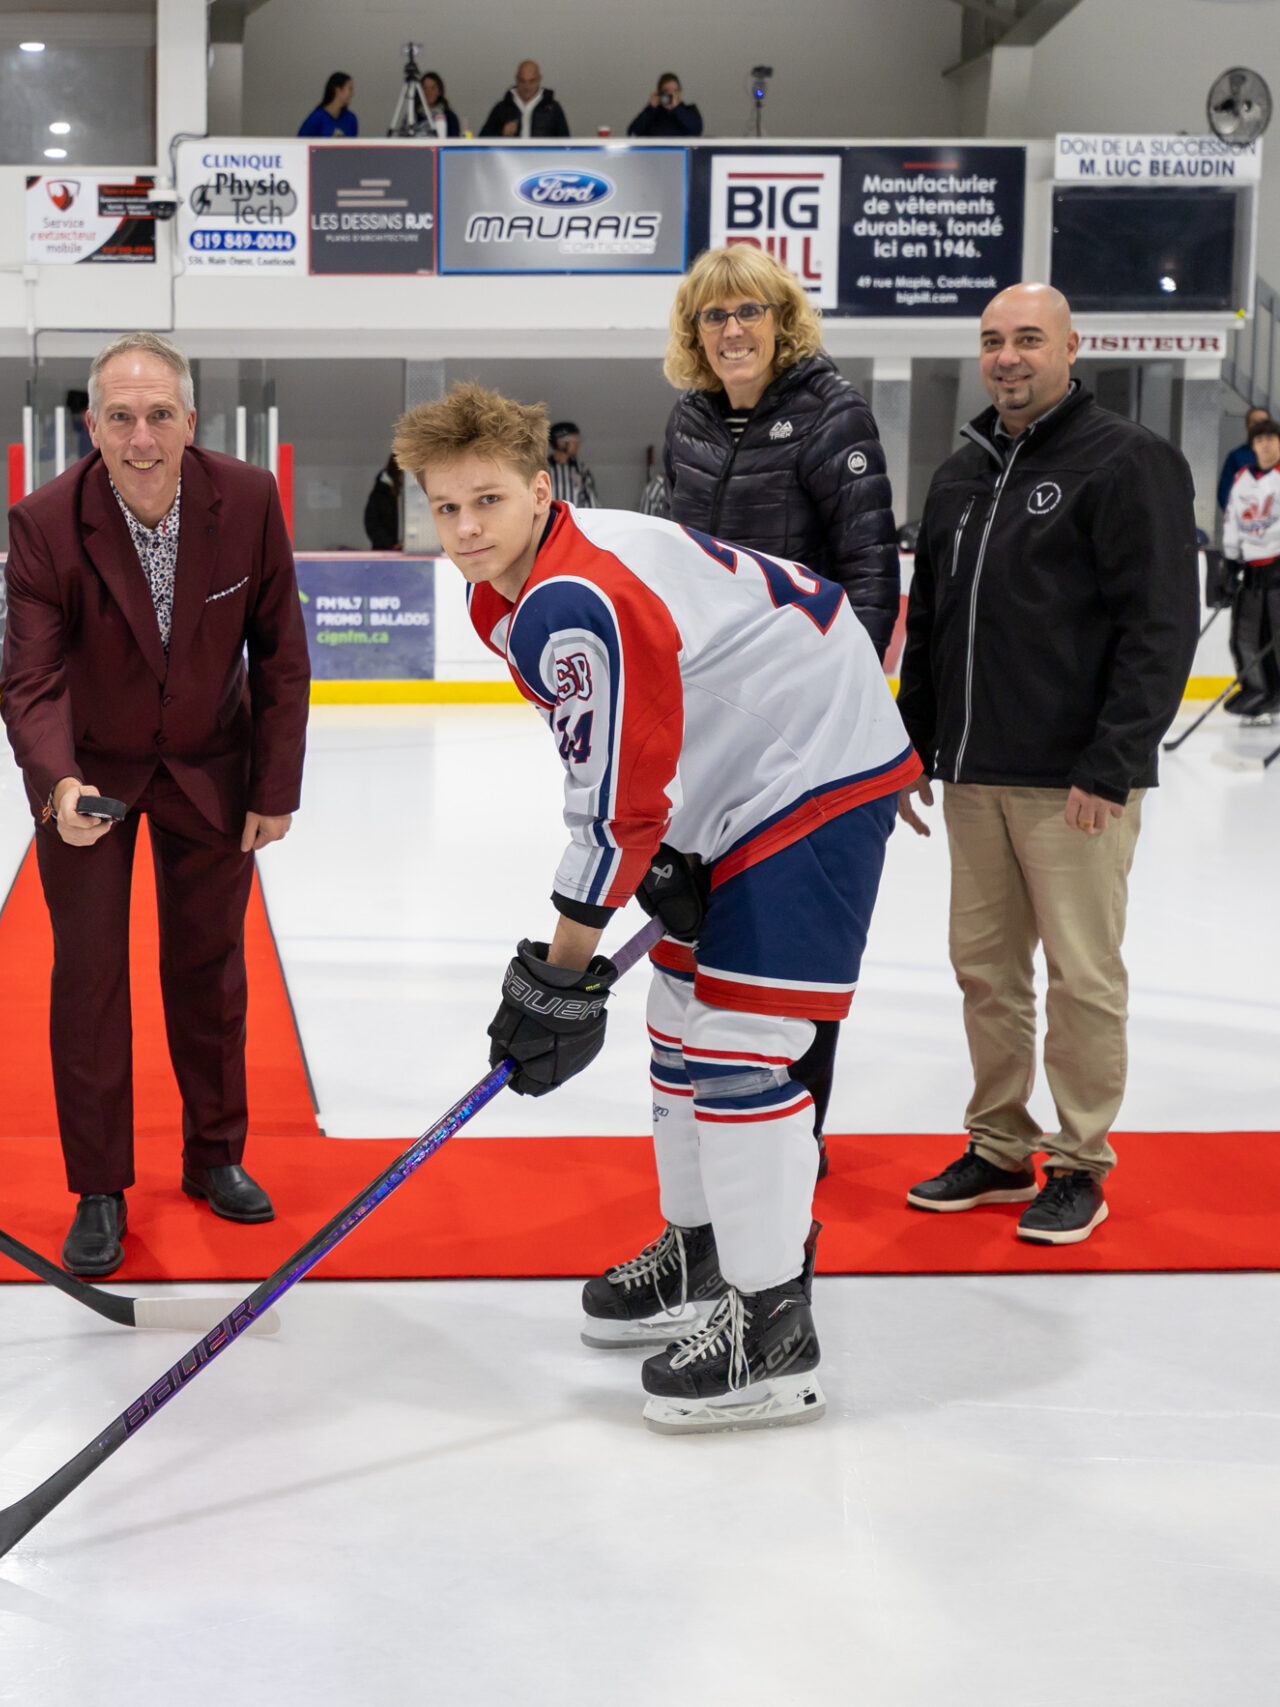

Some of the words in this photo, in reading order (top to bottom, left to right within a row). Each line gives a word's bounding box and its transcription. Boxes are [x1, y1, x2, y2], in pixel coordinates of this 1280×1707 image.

[1060, 139, 1097, 155] DON
[1101, 139, 1122, 155] DE
[1126, 140, 1146, 156] LA
[1150, 139, 1256, 157] SUCCESSION
[202, 154, 282, 170] CLINIQUE
[1079, 159, 1101, 175] M.
[1106, 160, 1141, 176] LUC
[1149, 160, 1235, 177] BEAUDIN
[215, 173, 290, 202] Physio
[532, 175, 595, 202] Ford
[863, 174, 996, 193] Manufacturier
[232, 199, 283, 224] Tech
[726, 186, 820, 229] BIG
[863, 196, 890, 214] de
[894, 195, 995, 215] vêtements
[43, 217, 84, 229] Service
[311, 213, 339, 230] LES
[341, 213, 403, 230] DESSINS
[405, 213, 433, 229] RJC
[469, 216, 658, 239] MAURAIS
[853, 218, 942, 237] durables,
[947, 215, 1003, 236] fondé
[47, 244, 81, 253] mobile
[193, 233, 222, 250] 819
[224, 233, 292, 250] 849-0044
[874, 240, 897, 258] ici
[901, 243, 927, 258] en
[933, 239, 981, 258] 1946.
[726, 236, 821, 279] LL
[873, 278, 893, 288] rue
[369, 597, 401, 610] INFO
[316, 613, 362, 626] PROMO
[370, 612, 430, 626] BALADOS
[316, 630, 389, 646] cignfm.ca
[121, 1298, 258, 1437] BAUER
